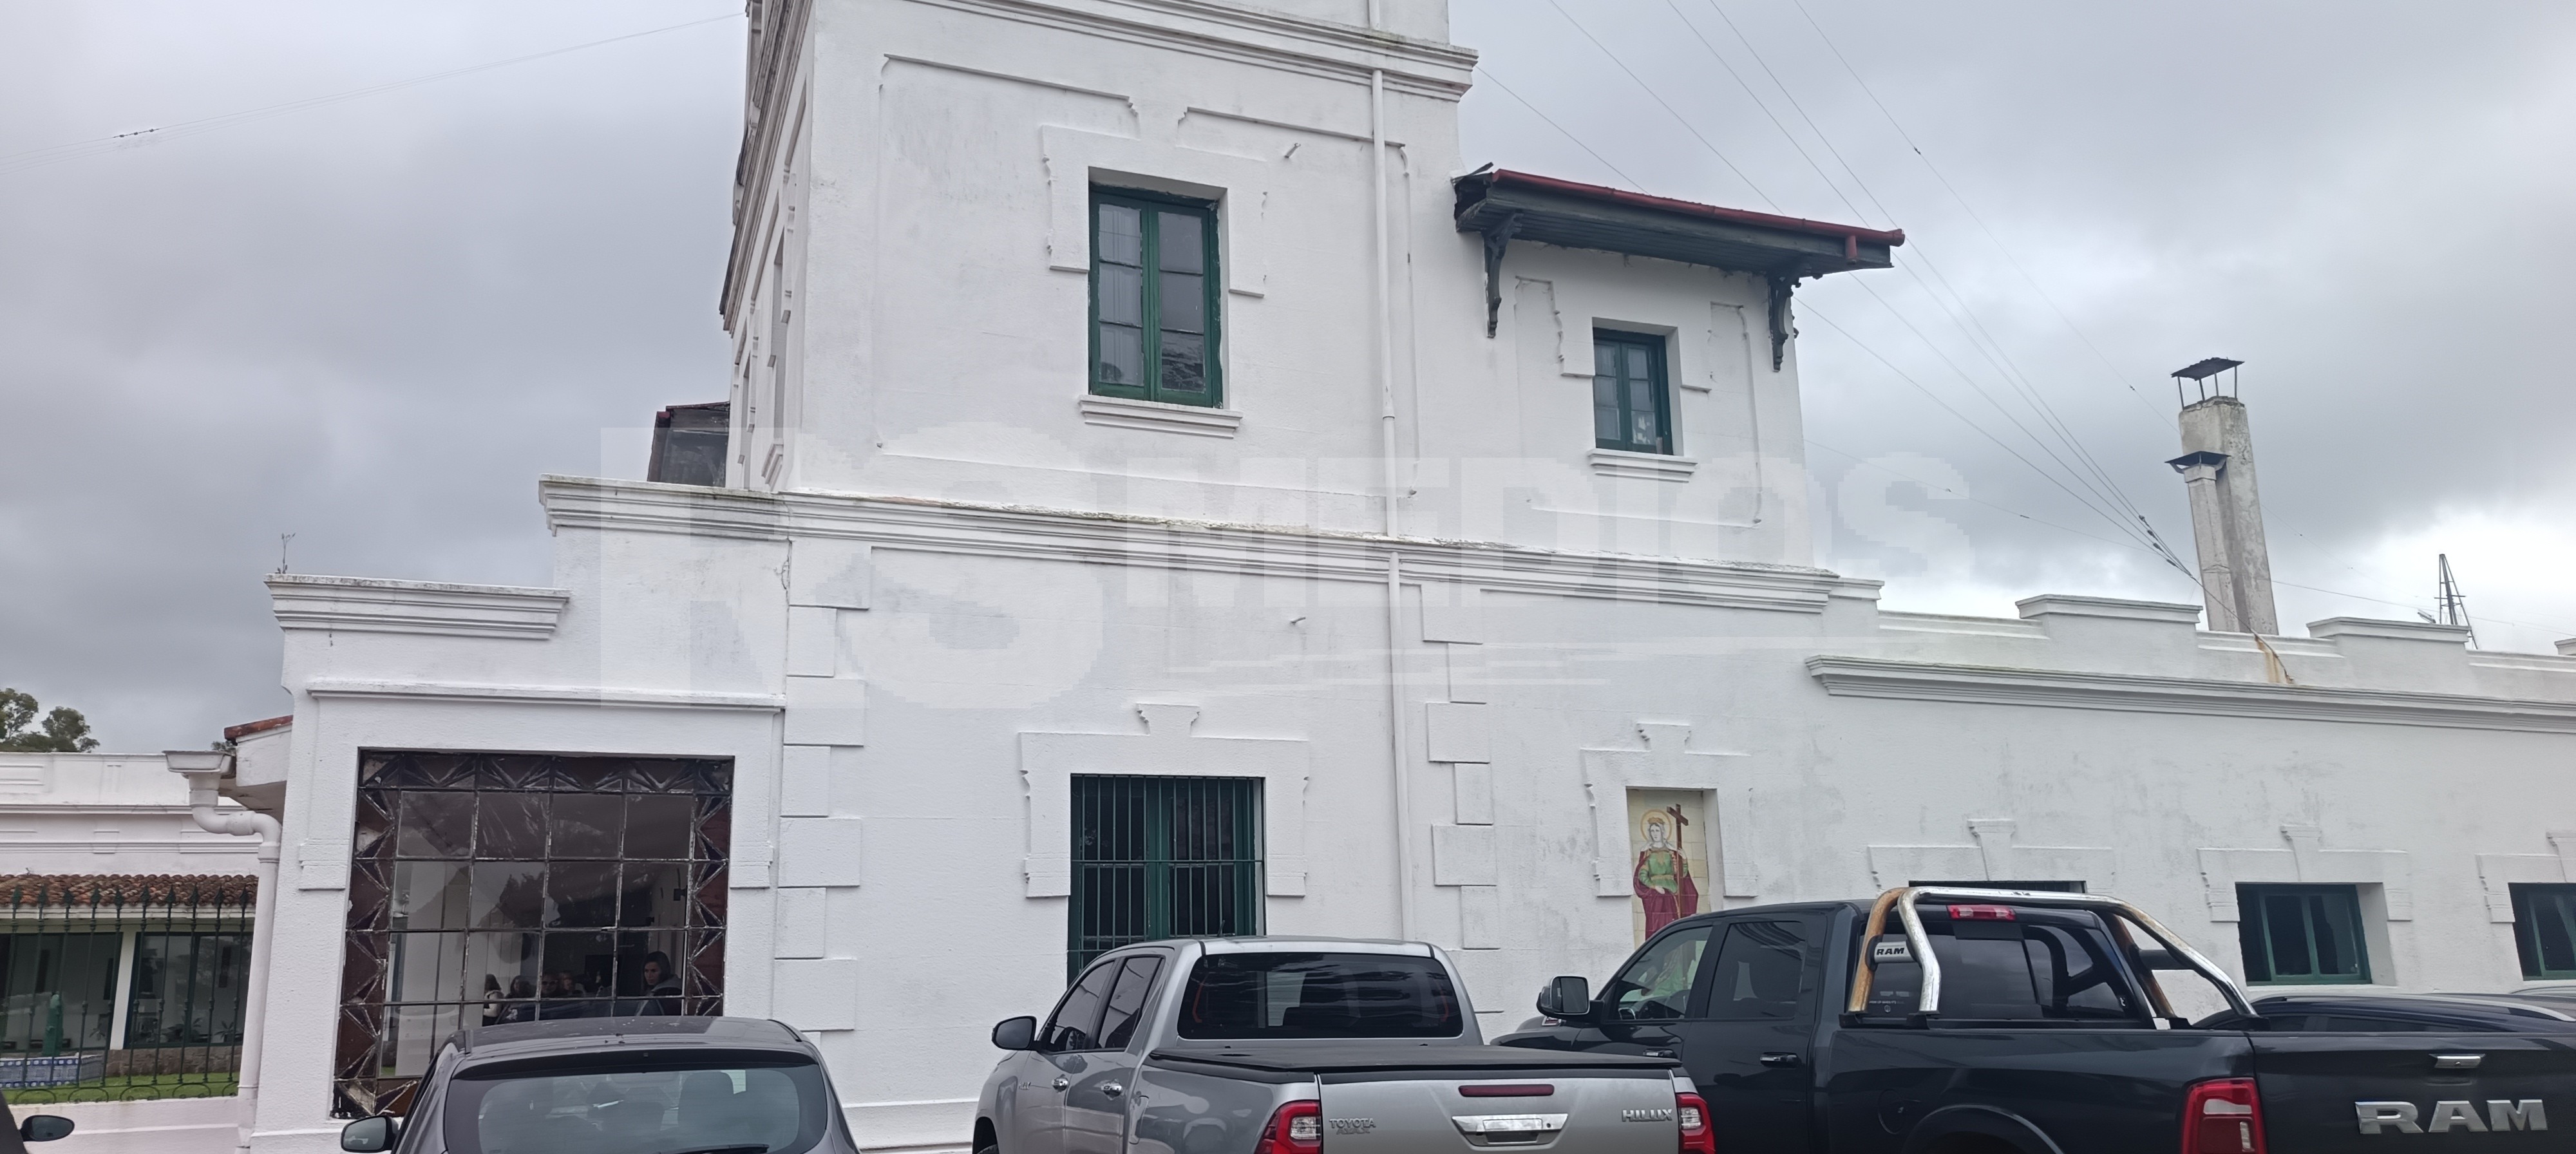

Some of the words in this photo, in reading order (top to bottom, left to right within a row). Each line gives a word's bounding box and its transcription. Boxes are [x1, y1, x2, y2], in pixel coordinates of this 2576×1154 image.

[1622, 1109, 1672, 1122] HILUX
[2354, 1099, 2548, 1134] RAM
[1329, 1118, 1376, 1129] TOYOTA
